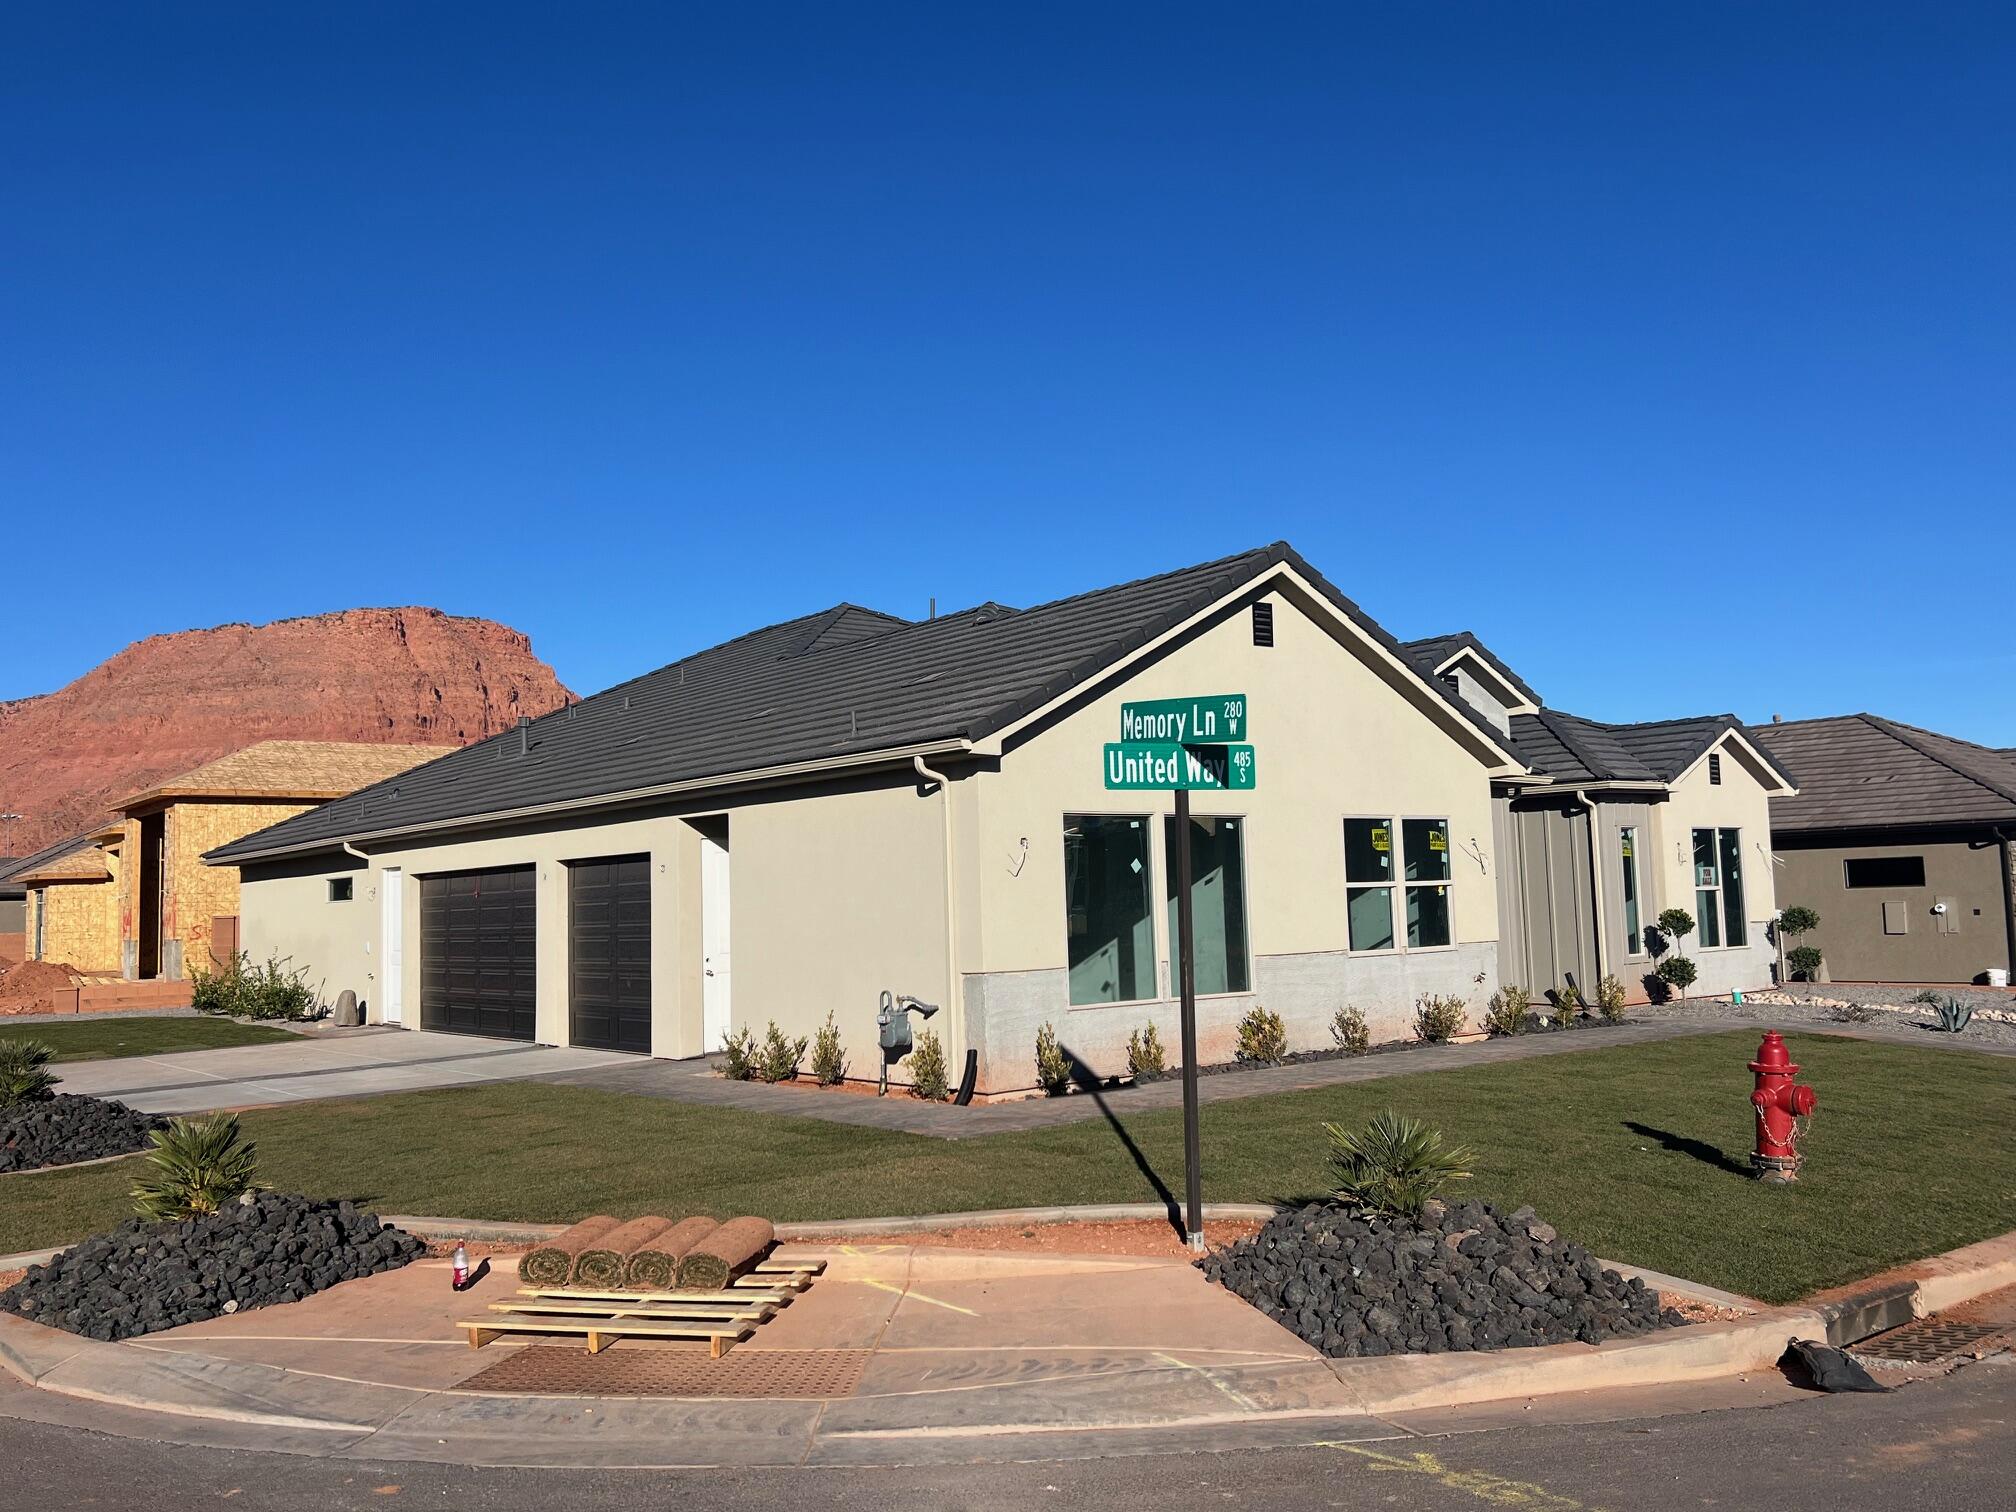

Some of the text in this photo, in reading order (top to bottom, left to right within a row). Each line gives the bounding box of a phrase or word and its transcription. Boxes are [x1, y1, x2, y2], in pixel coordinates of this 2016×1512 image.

[1224, 701, 1243, 719] 280
[1123, 704, 1216, 742] Memory Ln
[1229, 718, 1238, 735] W
[1233, 751, 1251, 767] 485
[1109, 750, 1225, 788] United Way
[1239, 768, 1246, 783] S
